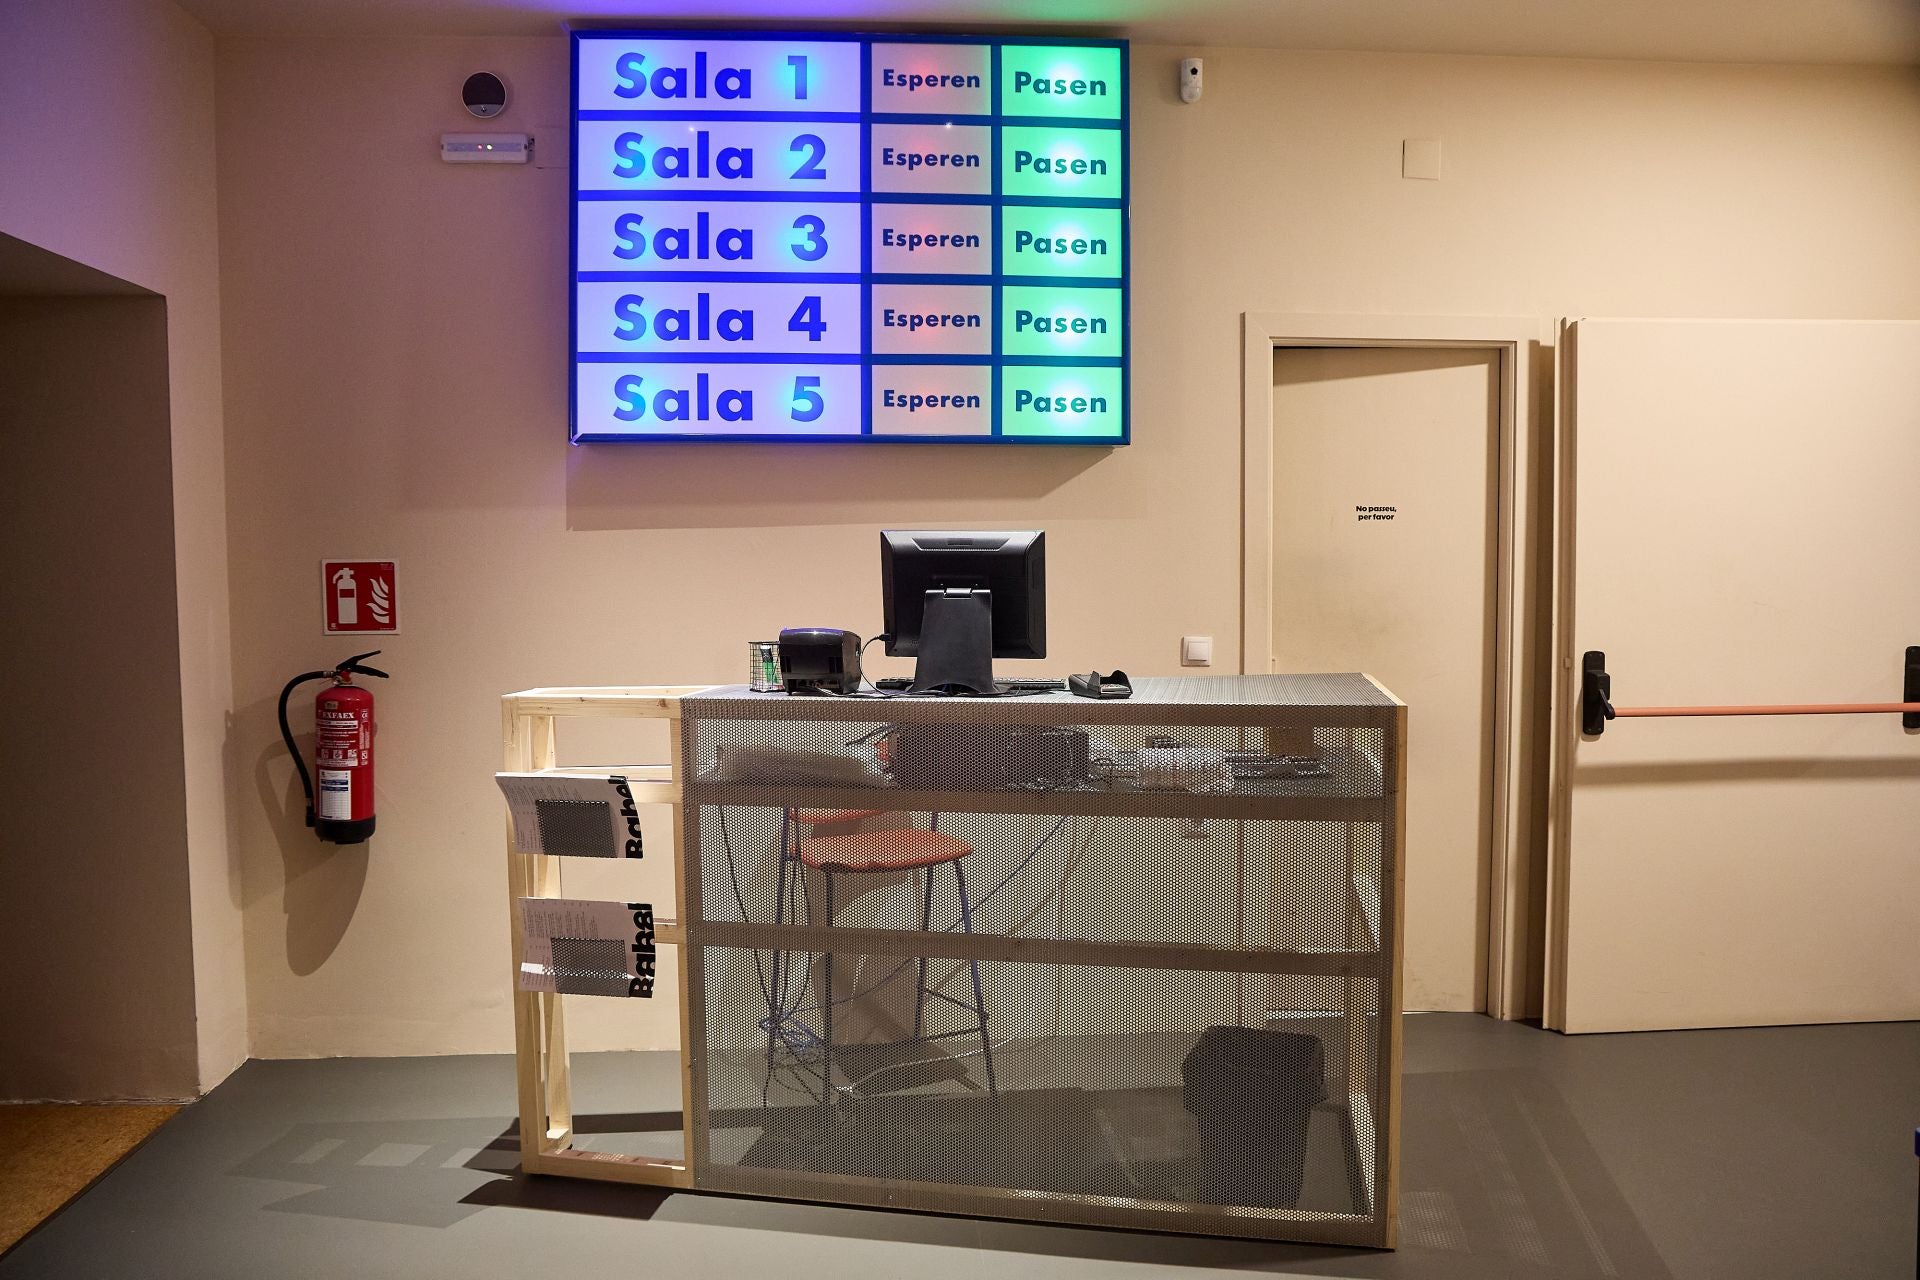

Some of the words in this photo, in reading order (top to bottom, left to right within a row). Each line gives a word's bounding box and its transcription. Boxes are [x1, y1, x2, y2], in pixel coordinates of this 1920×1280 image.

[613, 51, 752, 100] Sala
[783, 54, 809, 100] 1
[883, 68, 981, 92] Esperen
[1014, 70, 1107, 96] Pasen
[612, 130, 754, 180] Sala
[789, 133, 827, 180] 2
[882, 147, 980, 171] Esperen
[1014, 150, 1107, 176] Pasen
[612, 211, 753, 261] Sala
[790, 214, 829, 262] 3
[882, 228, 980, 252] Esperen
[1015, 230, 1107, 255] Pasen
[613, 292, 754, 342] Sala
[787, 295, 827, 342] 4
[883, 308, 981, 332] Esperen
[1015, 309, 1107, 334] Pasen
[613, 372, 753, 422] Sala
[790, 375, 825, 423] 5
[883, 389, 980, 413] Esperen
[1015, 389, 1107, 413] Pasen
[1358, 514, 1372, 522] per
[1368, 505, 1397, 513] passeu,
[627, 902, 656, 998] Babel
